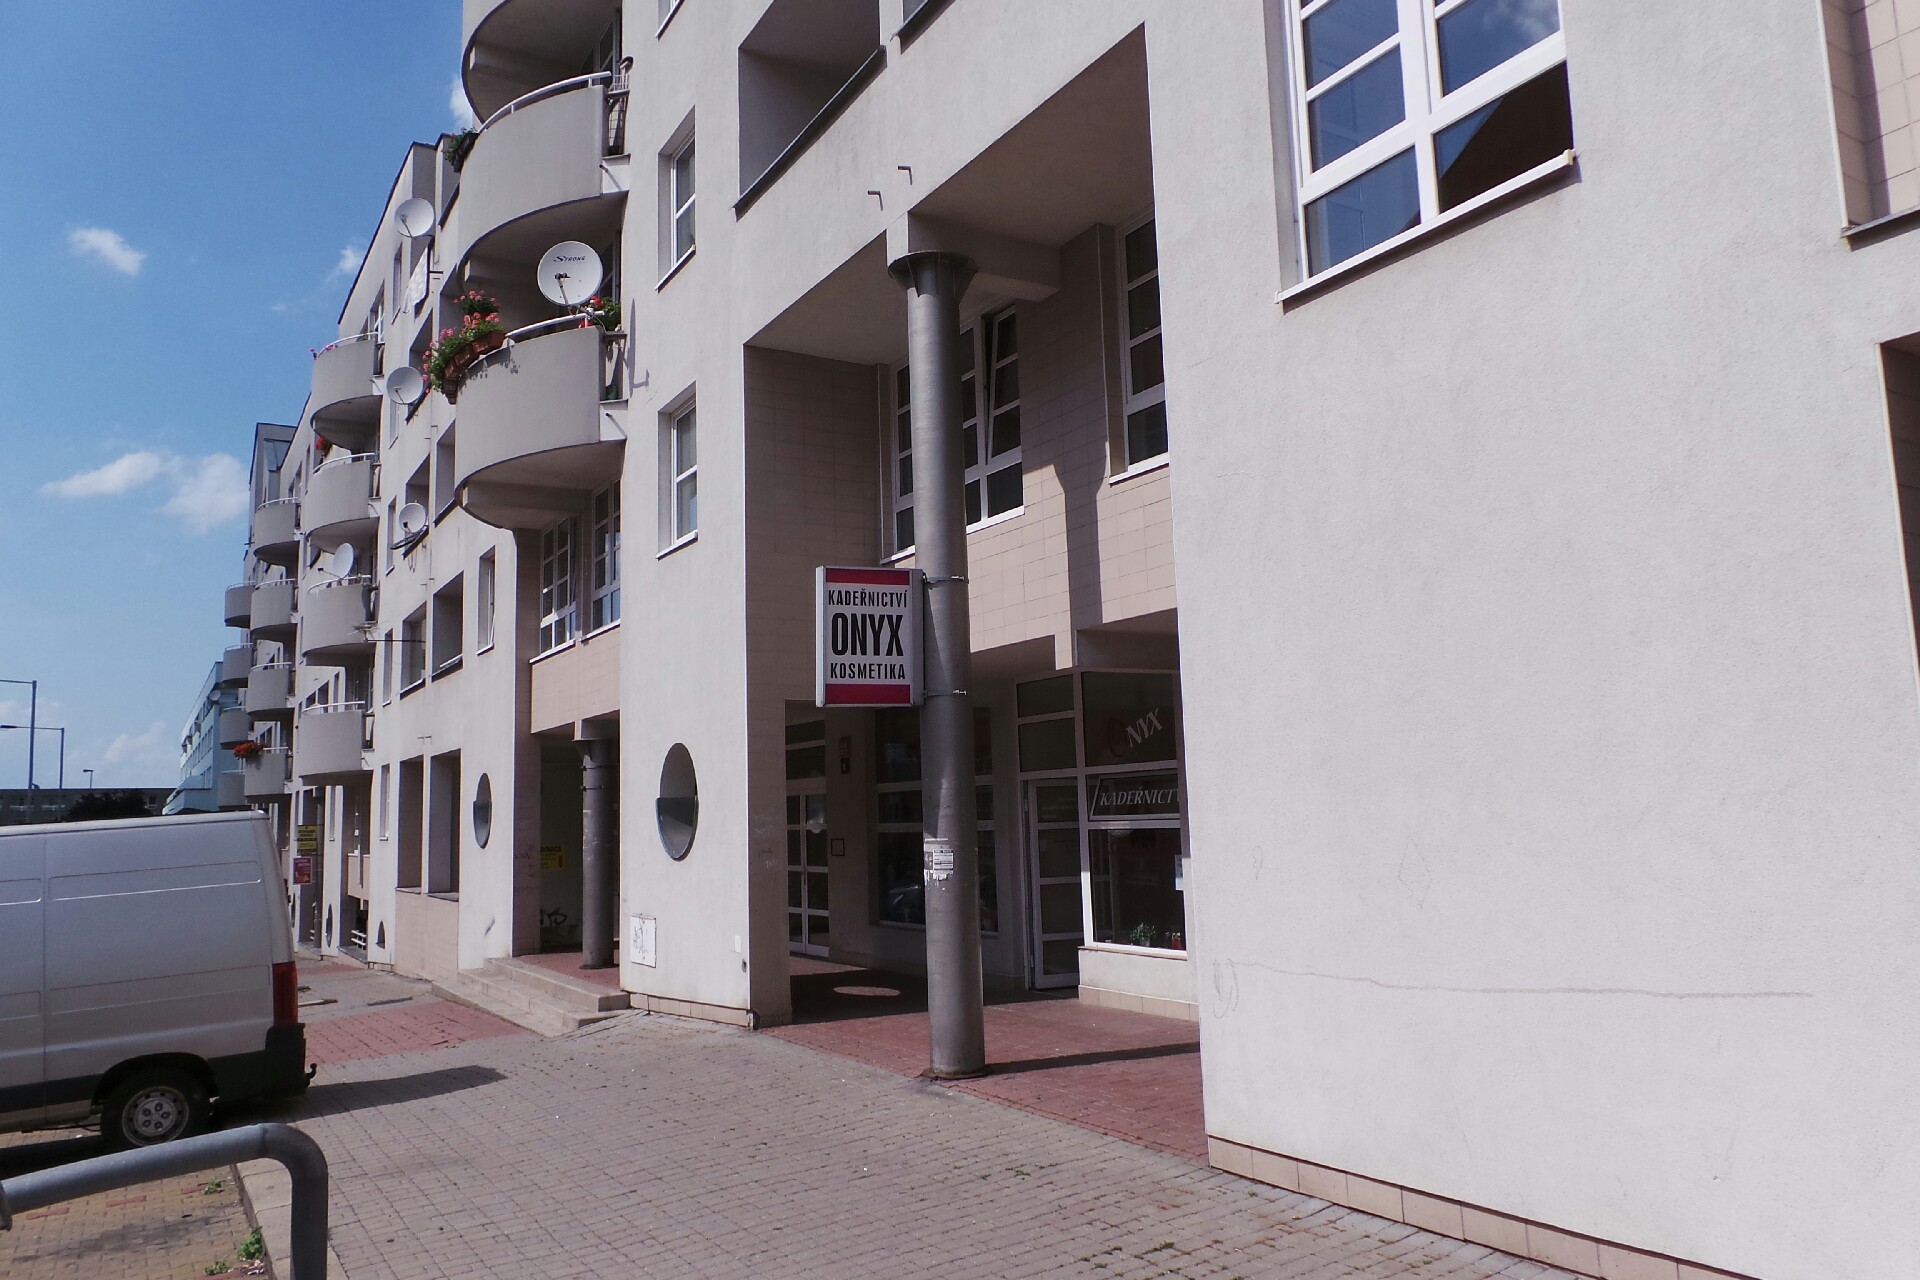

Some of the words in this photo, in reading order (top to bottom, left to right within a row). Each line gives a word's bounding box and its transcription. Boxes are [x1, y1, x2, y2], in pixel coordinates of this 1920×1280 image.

[828, 588, 908, 608] KADEŘNICTVÍ
[831, 612, 904, 657] ONYX
[830, 662, 906, 680] KOSMETIKA
